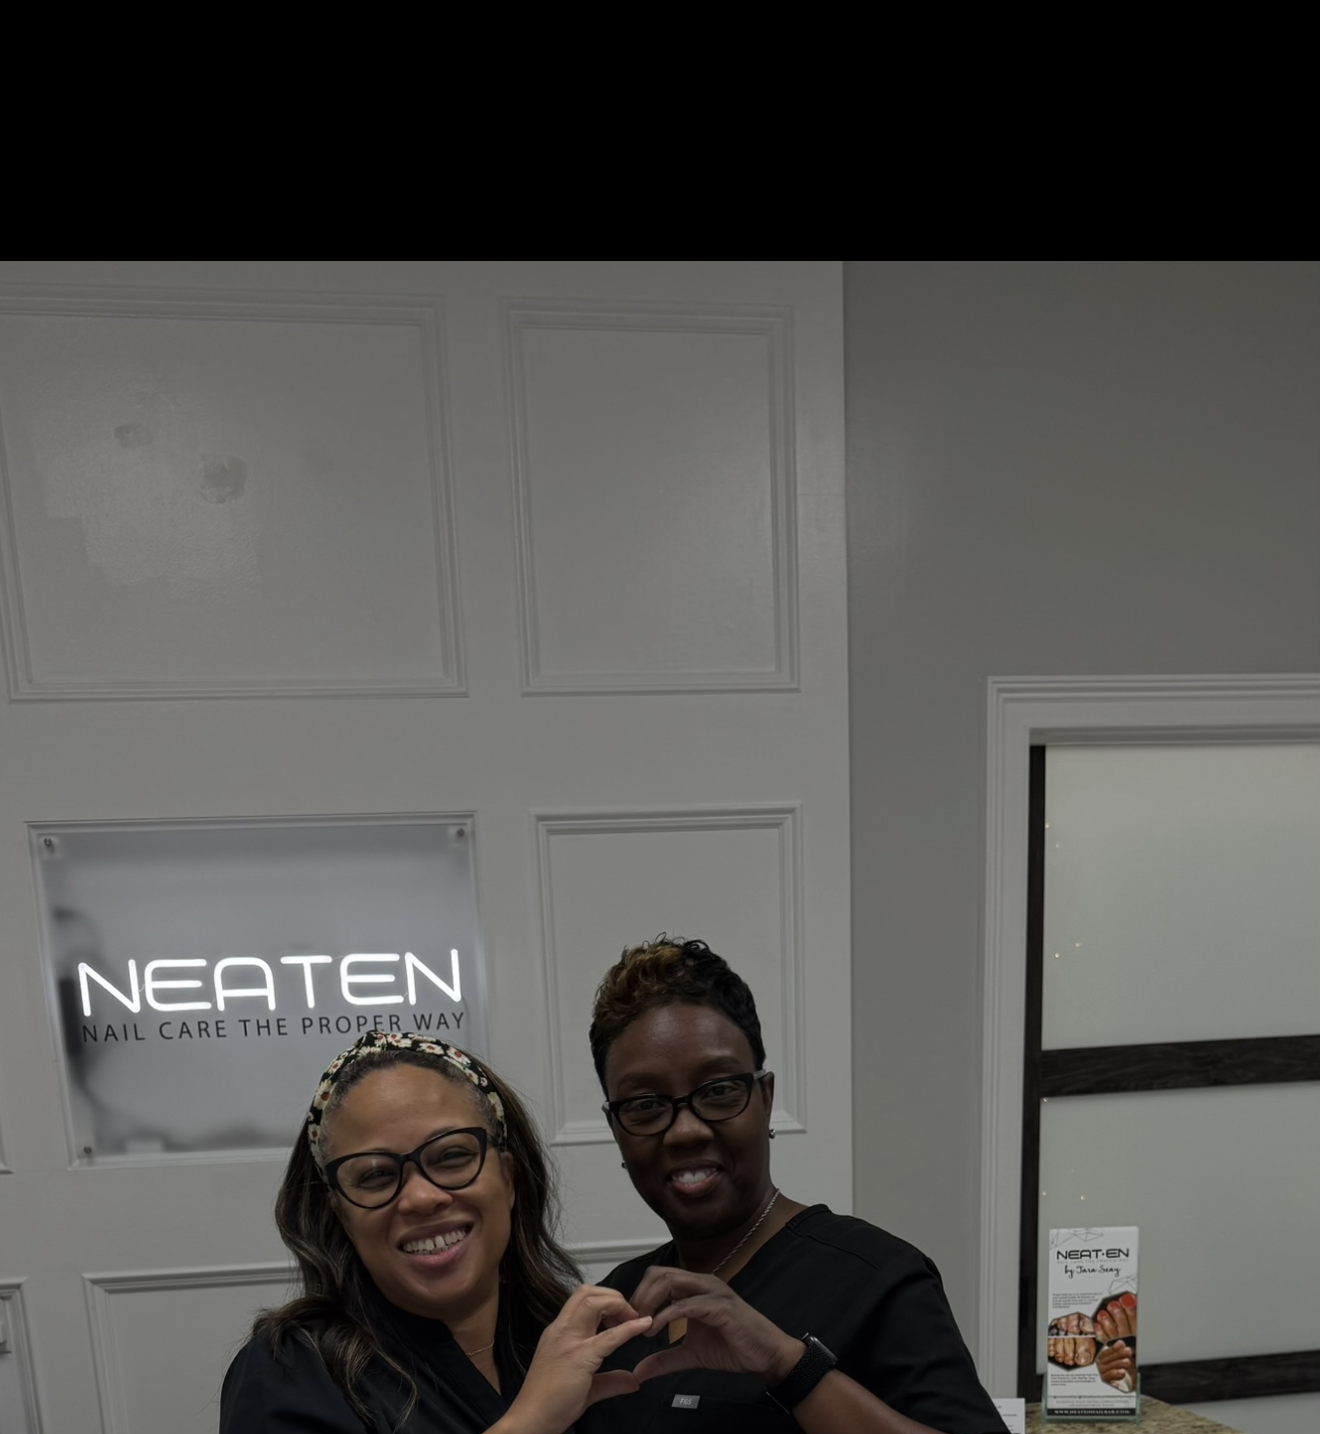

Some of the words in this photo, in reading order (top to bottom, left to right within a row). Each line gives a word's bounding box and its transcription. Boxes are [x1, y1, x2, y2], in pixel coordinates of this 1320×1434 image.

[78, 948, 462, 1017] NEATEN
[82, 1023, 146, 1043] NAIL
[159, 1020, 227, 1039] CARE
[238, 1017, 288, 1036] THE
[302, 1014, 402, 1034] PROPER
[413, 1011, 465, 1031] WAY
[1065, 1265, 1074, 1279] by
